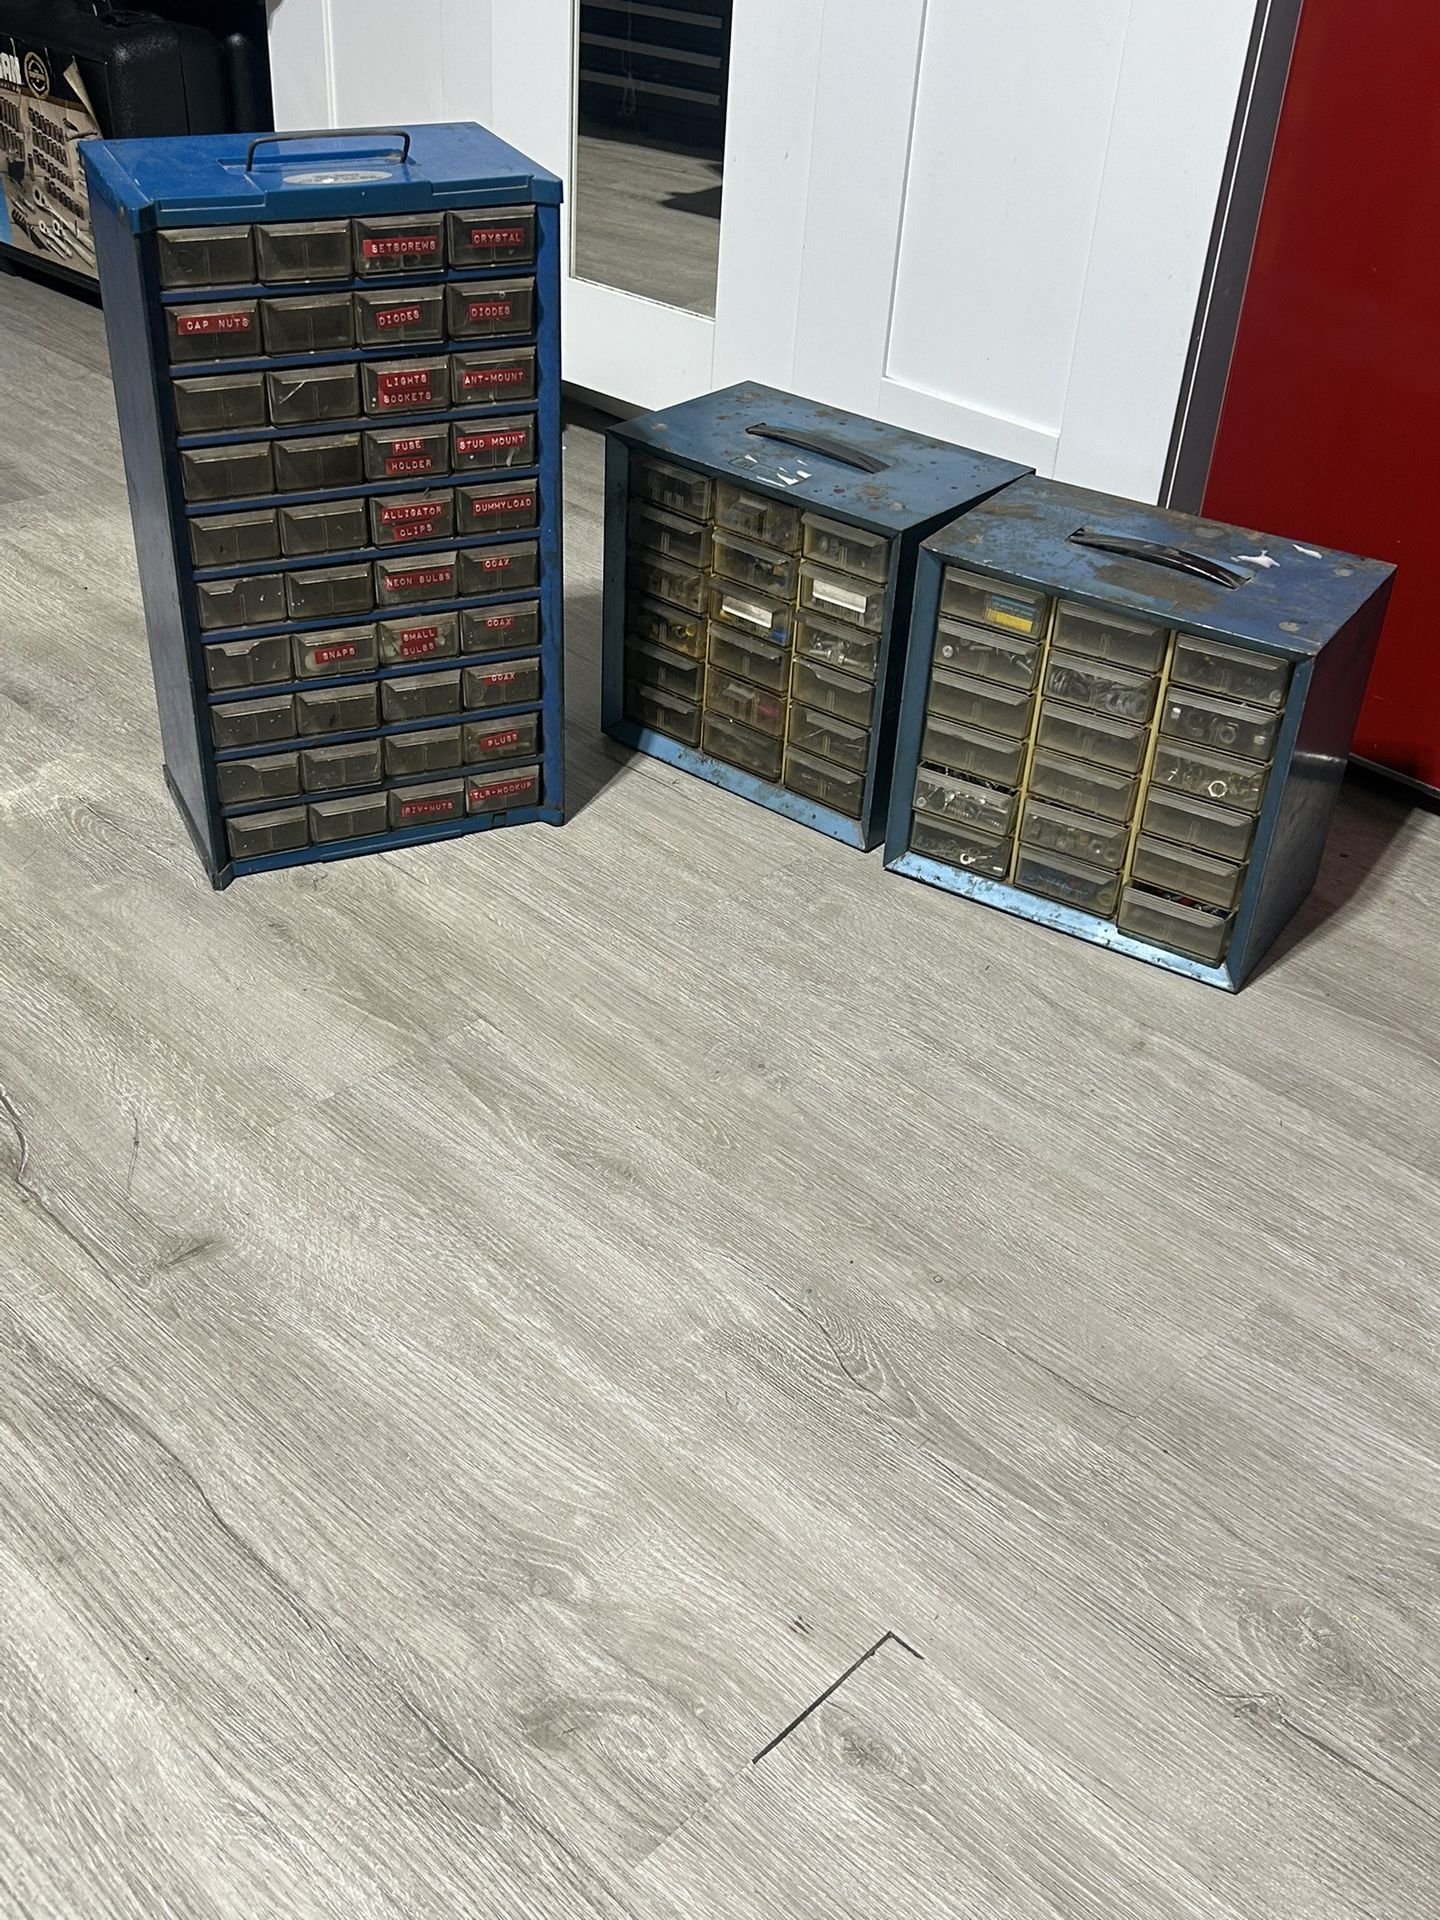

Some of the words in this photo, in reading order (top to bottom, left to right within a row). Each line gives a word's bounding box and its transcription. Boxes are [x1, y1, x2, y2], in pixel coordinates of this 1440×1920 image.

[473, 231, 521, 244] CRYSTAL
[371, 239, 437, 254] SETSCREWS
[378, 310, 420, 326] DIODES
[471, 304, 511, 318] DIODES
[186, 320, 209, 331] CAP
[218, 317, 250, 329] NUTS
[386, 373, 428, 388] LIGHTS
[464, 371, 524, 386] ANT-MOUNT
[383, 391, 432, 404] SOCKETS
[394, 440, 422, 452] FUSE
[459, 439, 485, 451] STUD
[491, 434, 525, 447] MOUNT
[391, 459, 432, 471] HOLDER
[475, 498, 532, 514] DUMMYLOAD
[383, 506, 442, 521] ALLIGATOR
[400, 524, 433, 538] CLIPS
[485, 559, 510, 569] COAX
[386, 576, 412, 589] NEON
[419, 572, 450, 584] BULBS
[487, 618, 512, 628] COAX
[403, 629, 435, 642] SMALL
[322, 647, 356, 661] SNAPS
[403, 642, 435, 656] BULBS
[491, 673, 516, 682] COAX
